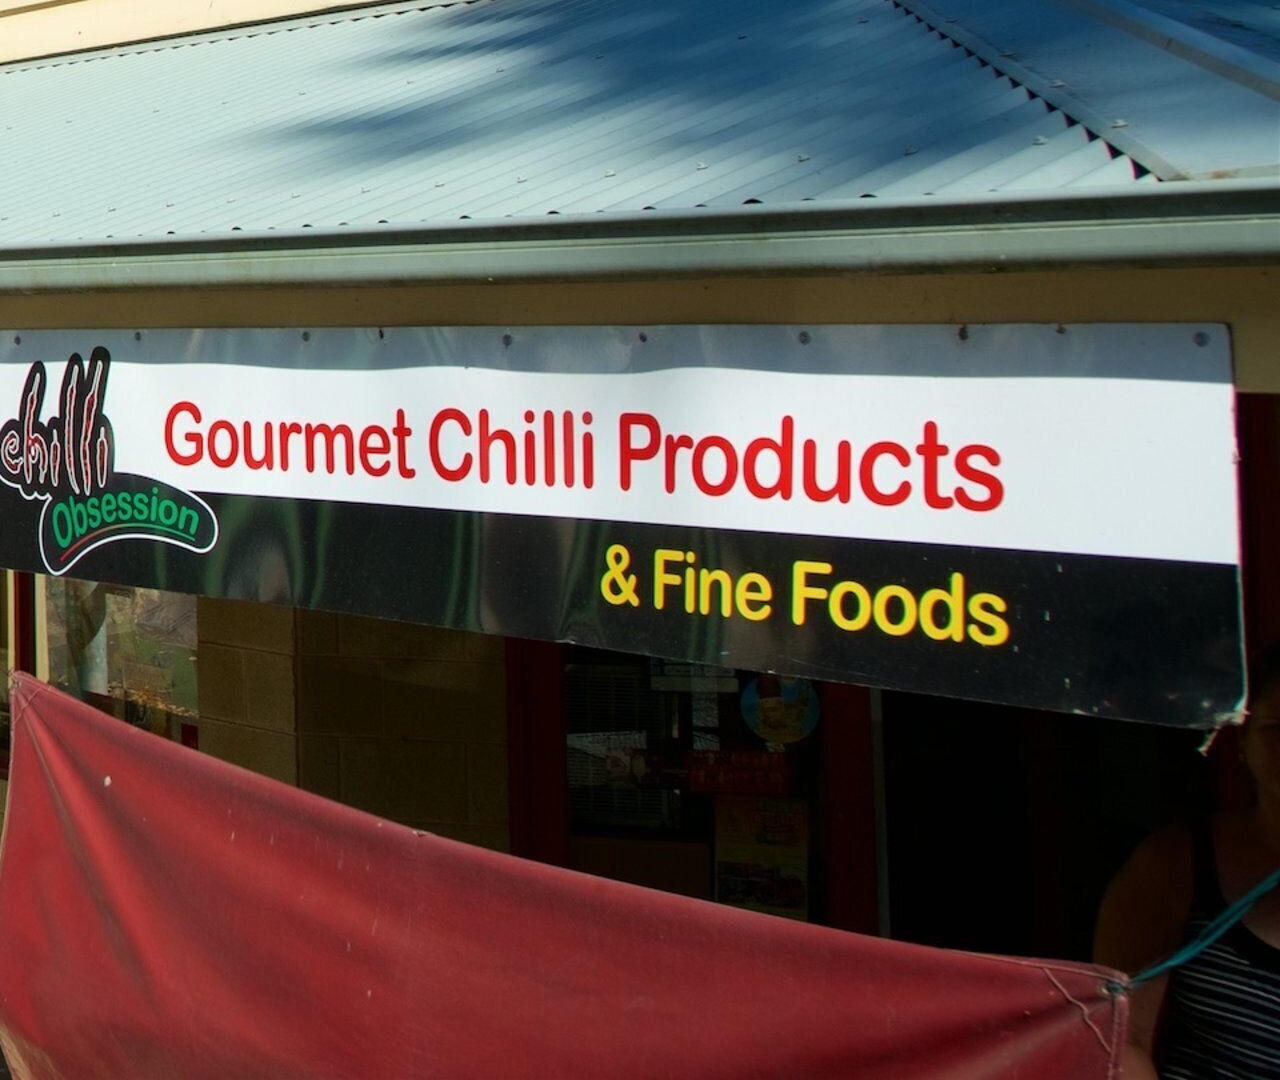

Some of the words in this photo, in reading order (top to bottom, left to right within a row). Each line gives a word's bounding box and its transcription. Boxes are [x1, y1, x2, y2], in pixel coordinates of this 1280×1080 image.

[0, 359, 110, 497] chilli
[164, 401, 416, 479] Gourmet
[429, 407, 594, 489] Chilli
[619, 412, 1006, 513] Products
[52, 486, 200, 548] Obsession
[600, 543, 640, 608] &
[653, 548, 774, 622] Fine
[791, 560, 1011, 647] Foods
